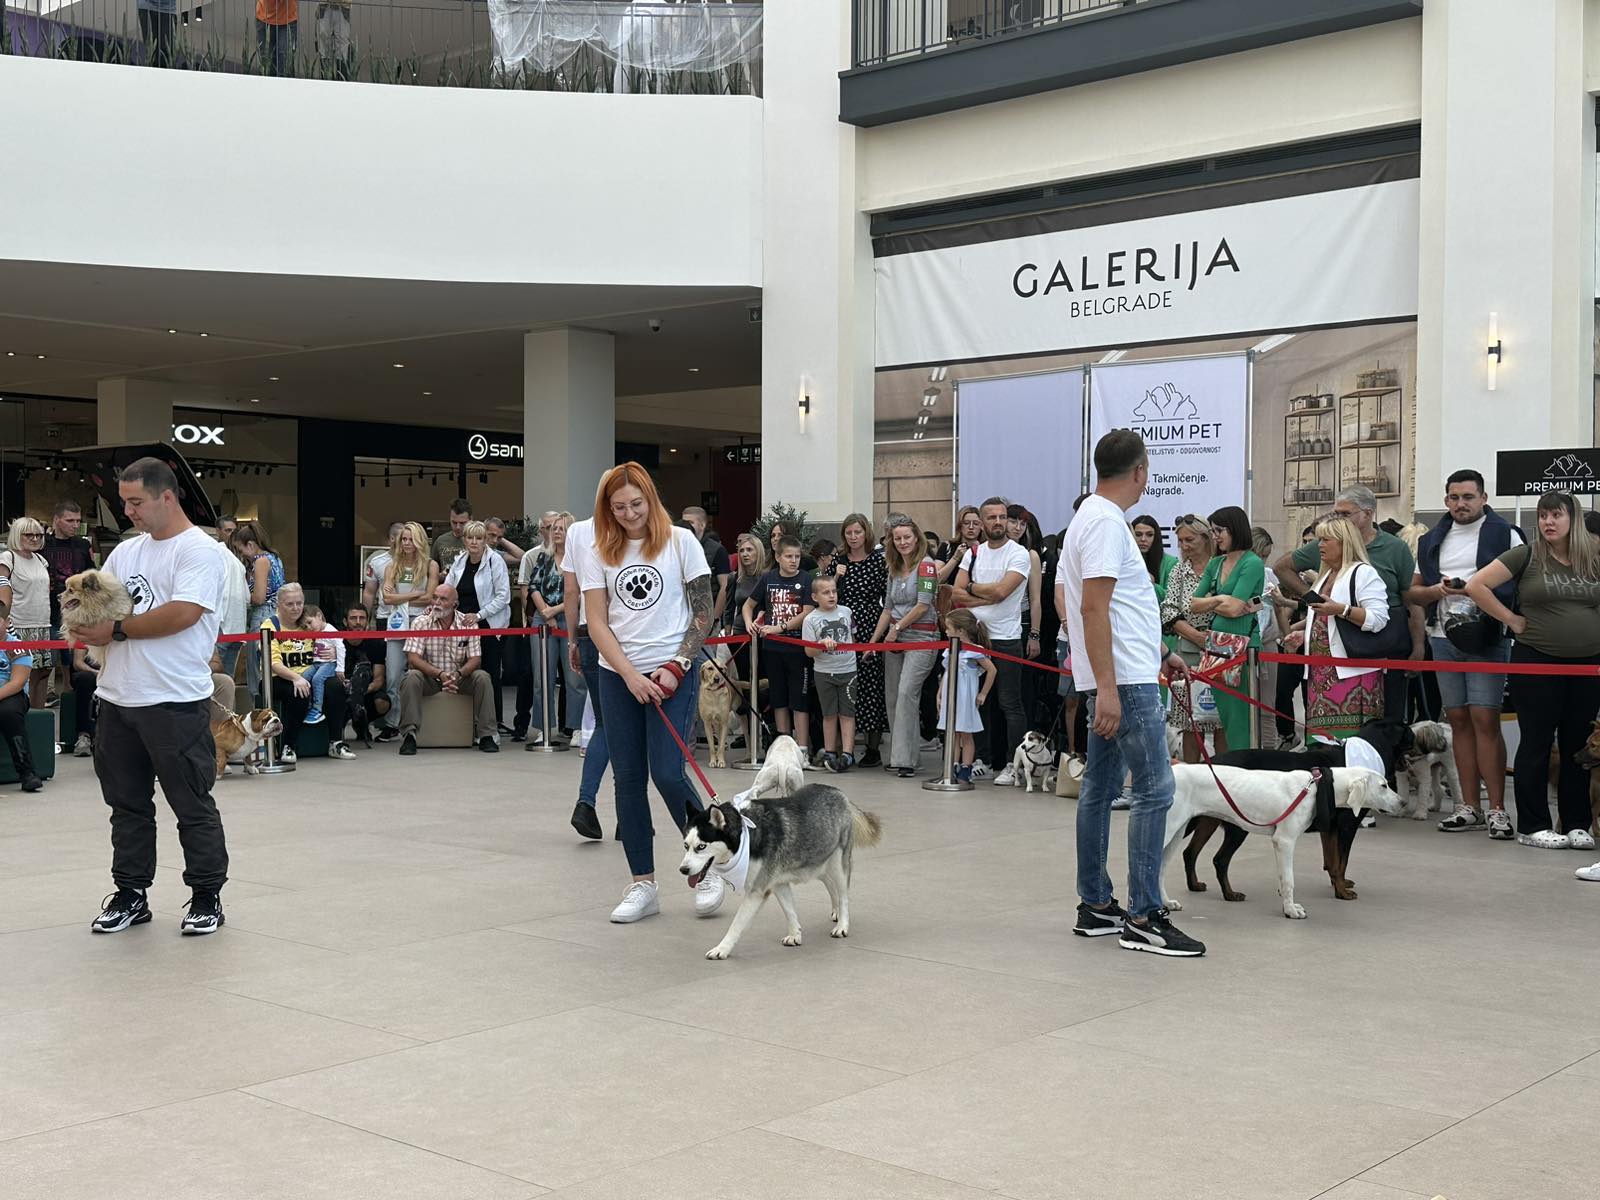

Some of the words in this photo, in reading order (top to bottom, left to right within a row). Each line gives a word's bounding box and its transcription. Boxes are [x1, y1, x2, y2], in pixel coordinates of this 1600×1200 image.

[1013, 237, 1240, 298] GALERIJA
[1070, 290, 1172, 318] BELGRADE
[172, 424, 225, 445] OX
[1111, 425, 1184, 441] MIUM
[1189, 423, 1222, 439] PET
[1152, 473, 1209, 485] Takmičenje.
[1524, 481, 1583, 492] PREMIUM
[1143, 486, 1185, 497] Nagrade.
[769, 588, 790, 603] THE
[771, 603, 799, 616] NEXT
